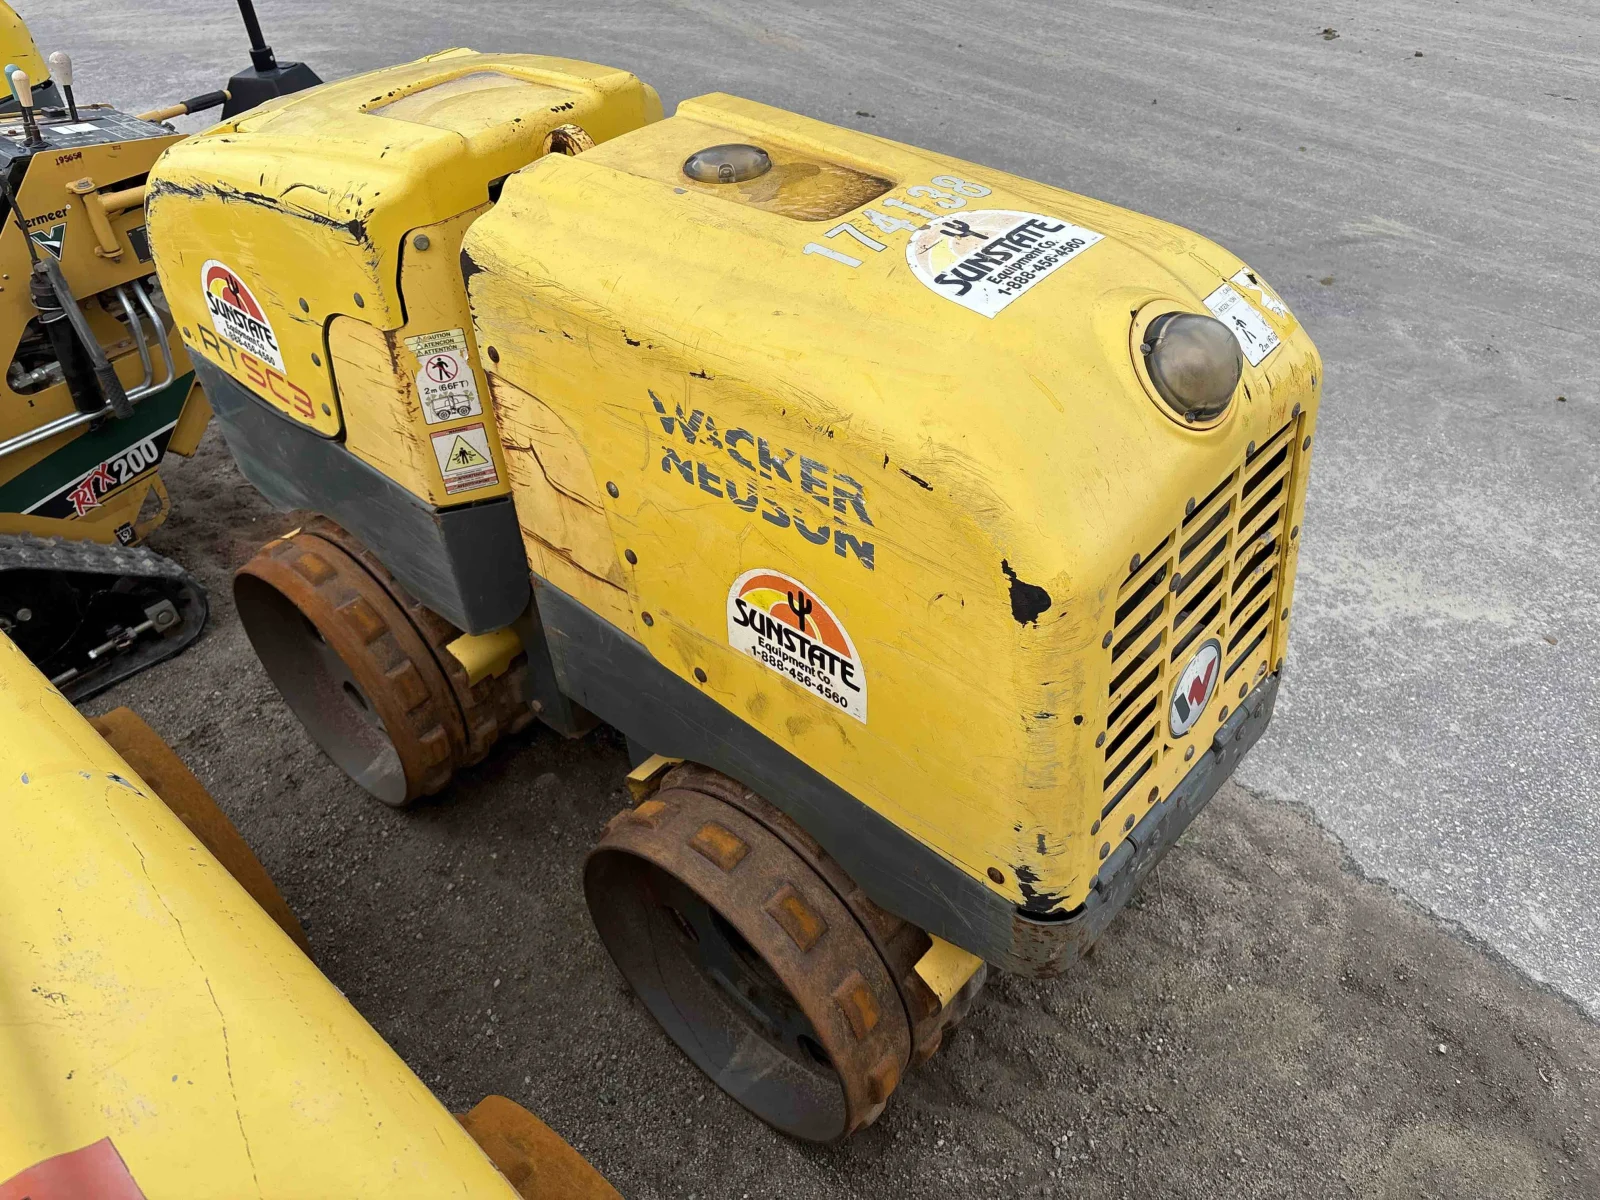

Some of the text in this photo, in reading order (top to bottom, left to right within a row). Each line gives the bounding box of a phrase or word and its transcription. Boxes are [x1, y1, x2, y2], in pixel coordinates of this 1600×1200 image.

[802, 174, 992, 269] 174138
[933, 218, 1066, 297] SUNSTATE
[986, 239, 1060, 285] Equipment Co.
[997, 238, 1086, 296] 1-888-456-4560
[206, 290, 277, 351] SUNSTATE
[424, 332, 451, 341] AUTION
[66, 440, 159, 516] RTX 200
[648, 389, 876, 527] WACKER
[661, 446, 875, 571] NEUSON
[733, 598, 861, 693] SUNSTATE
[751, 645, 848, 708] 1-888-456-4560
[758, 636, 834, 688] Equipment Co.
